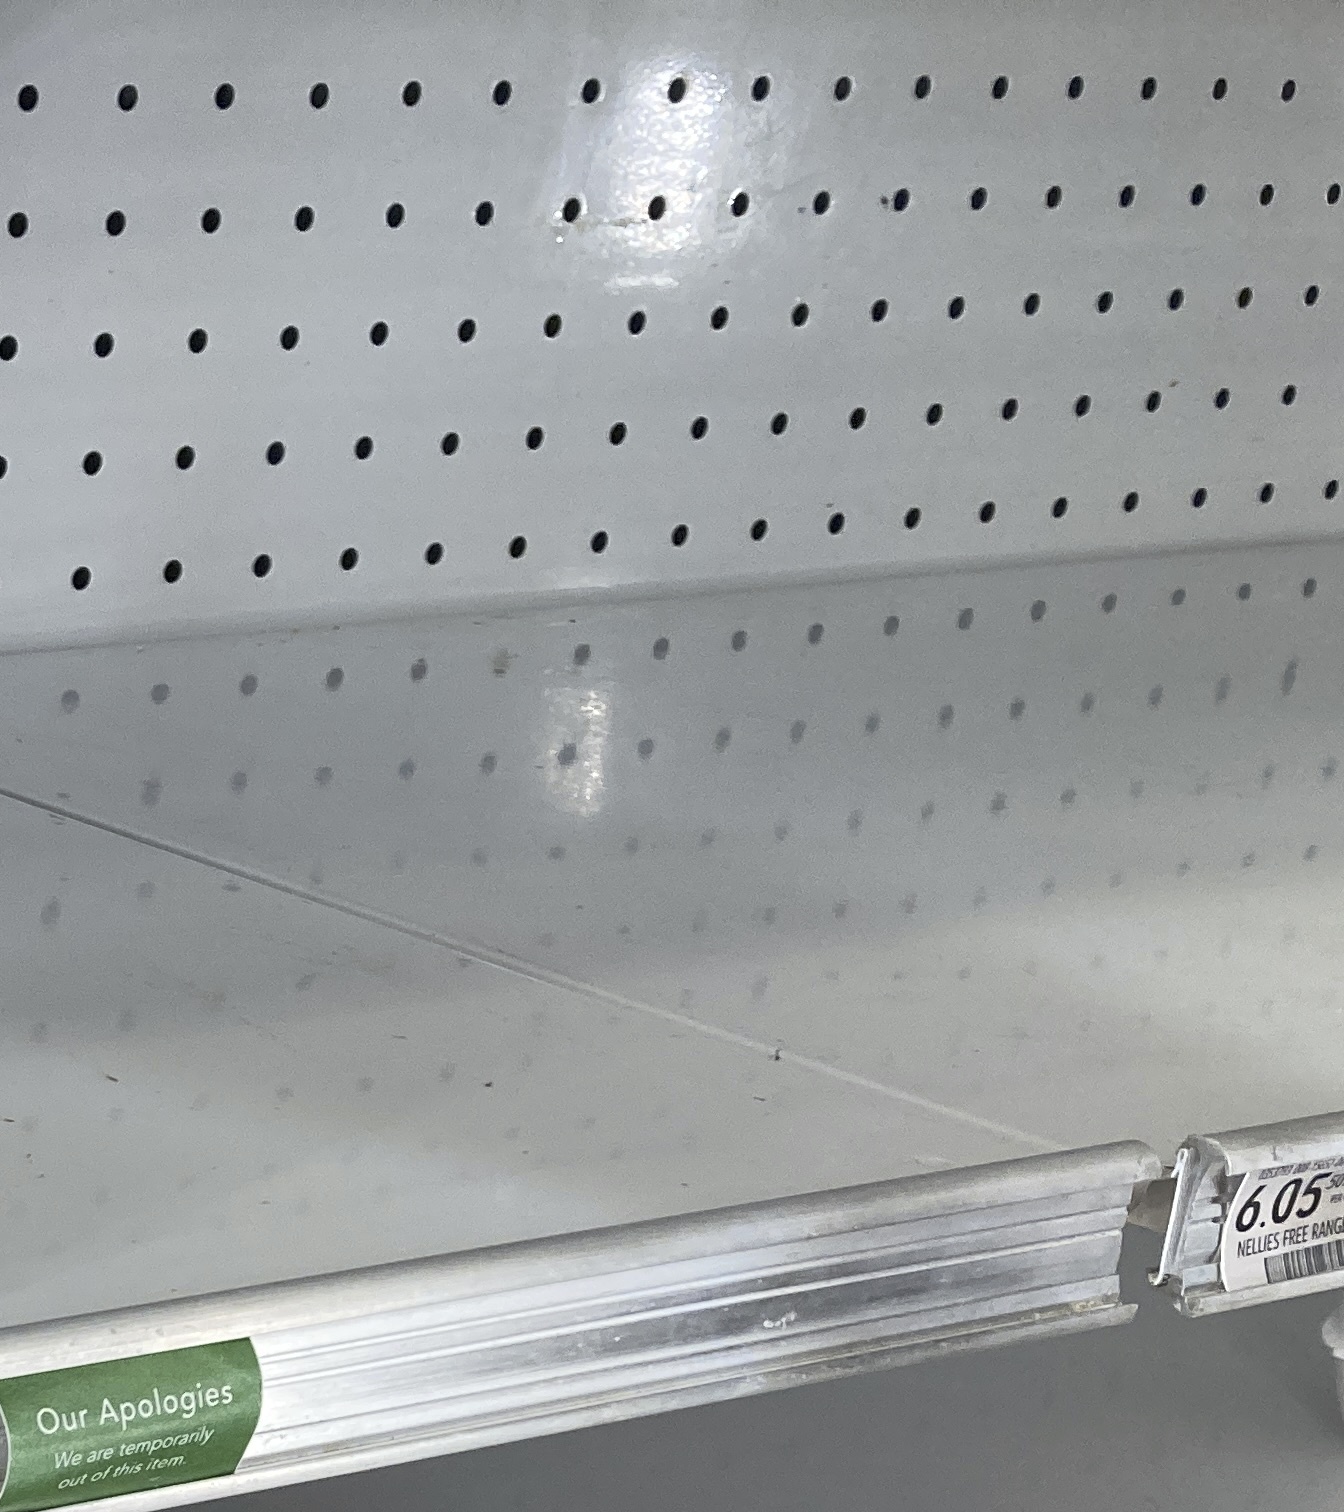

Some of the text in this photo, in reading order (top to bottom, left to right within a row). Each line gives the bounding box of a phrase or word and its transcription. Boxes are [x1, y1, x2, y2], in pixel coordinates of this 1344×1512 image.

[1234, 1171, 1333, 1233] 6.05
[1236, 1223, 1310, 1259] NELLIES FREE
[36, 1382, 233, 1435] Our Apologies
[54, 1425, 216, 1470] We are temporarily
[58, 1454, 187, 1490] out of this item.
